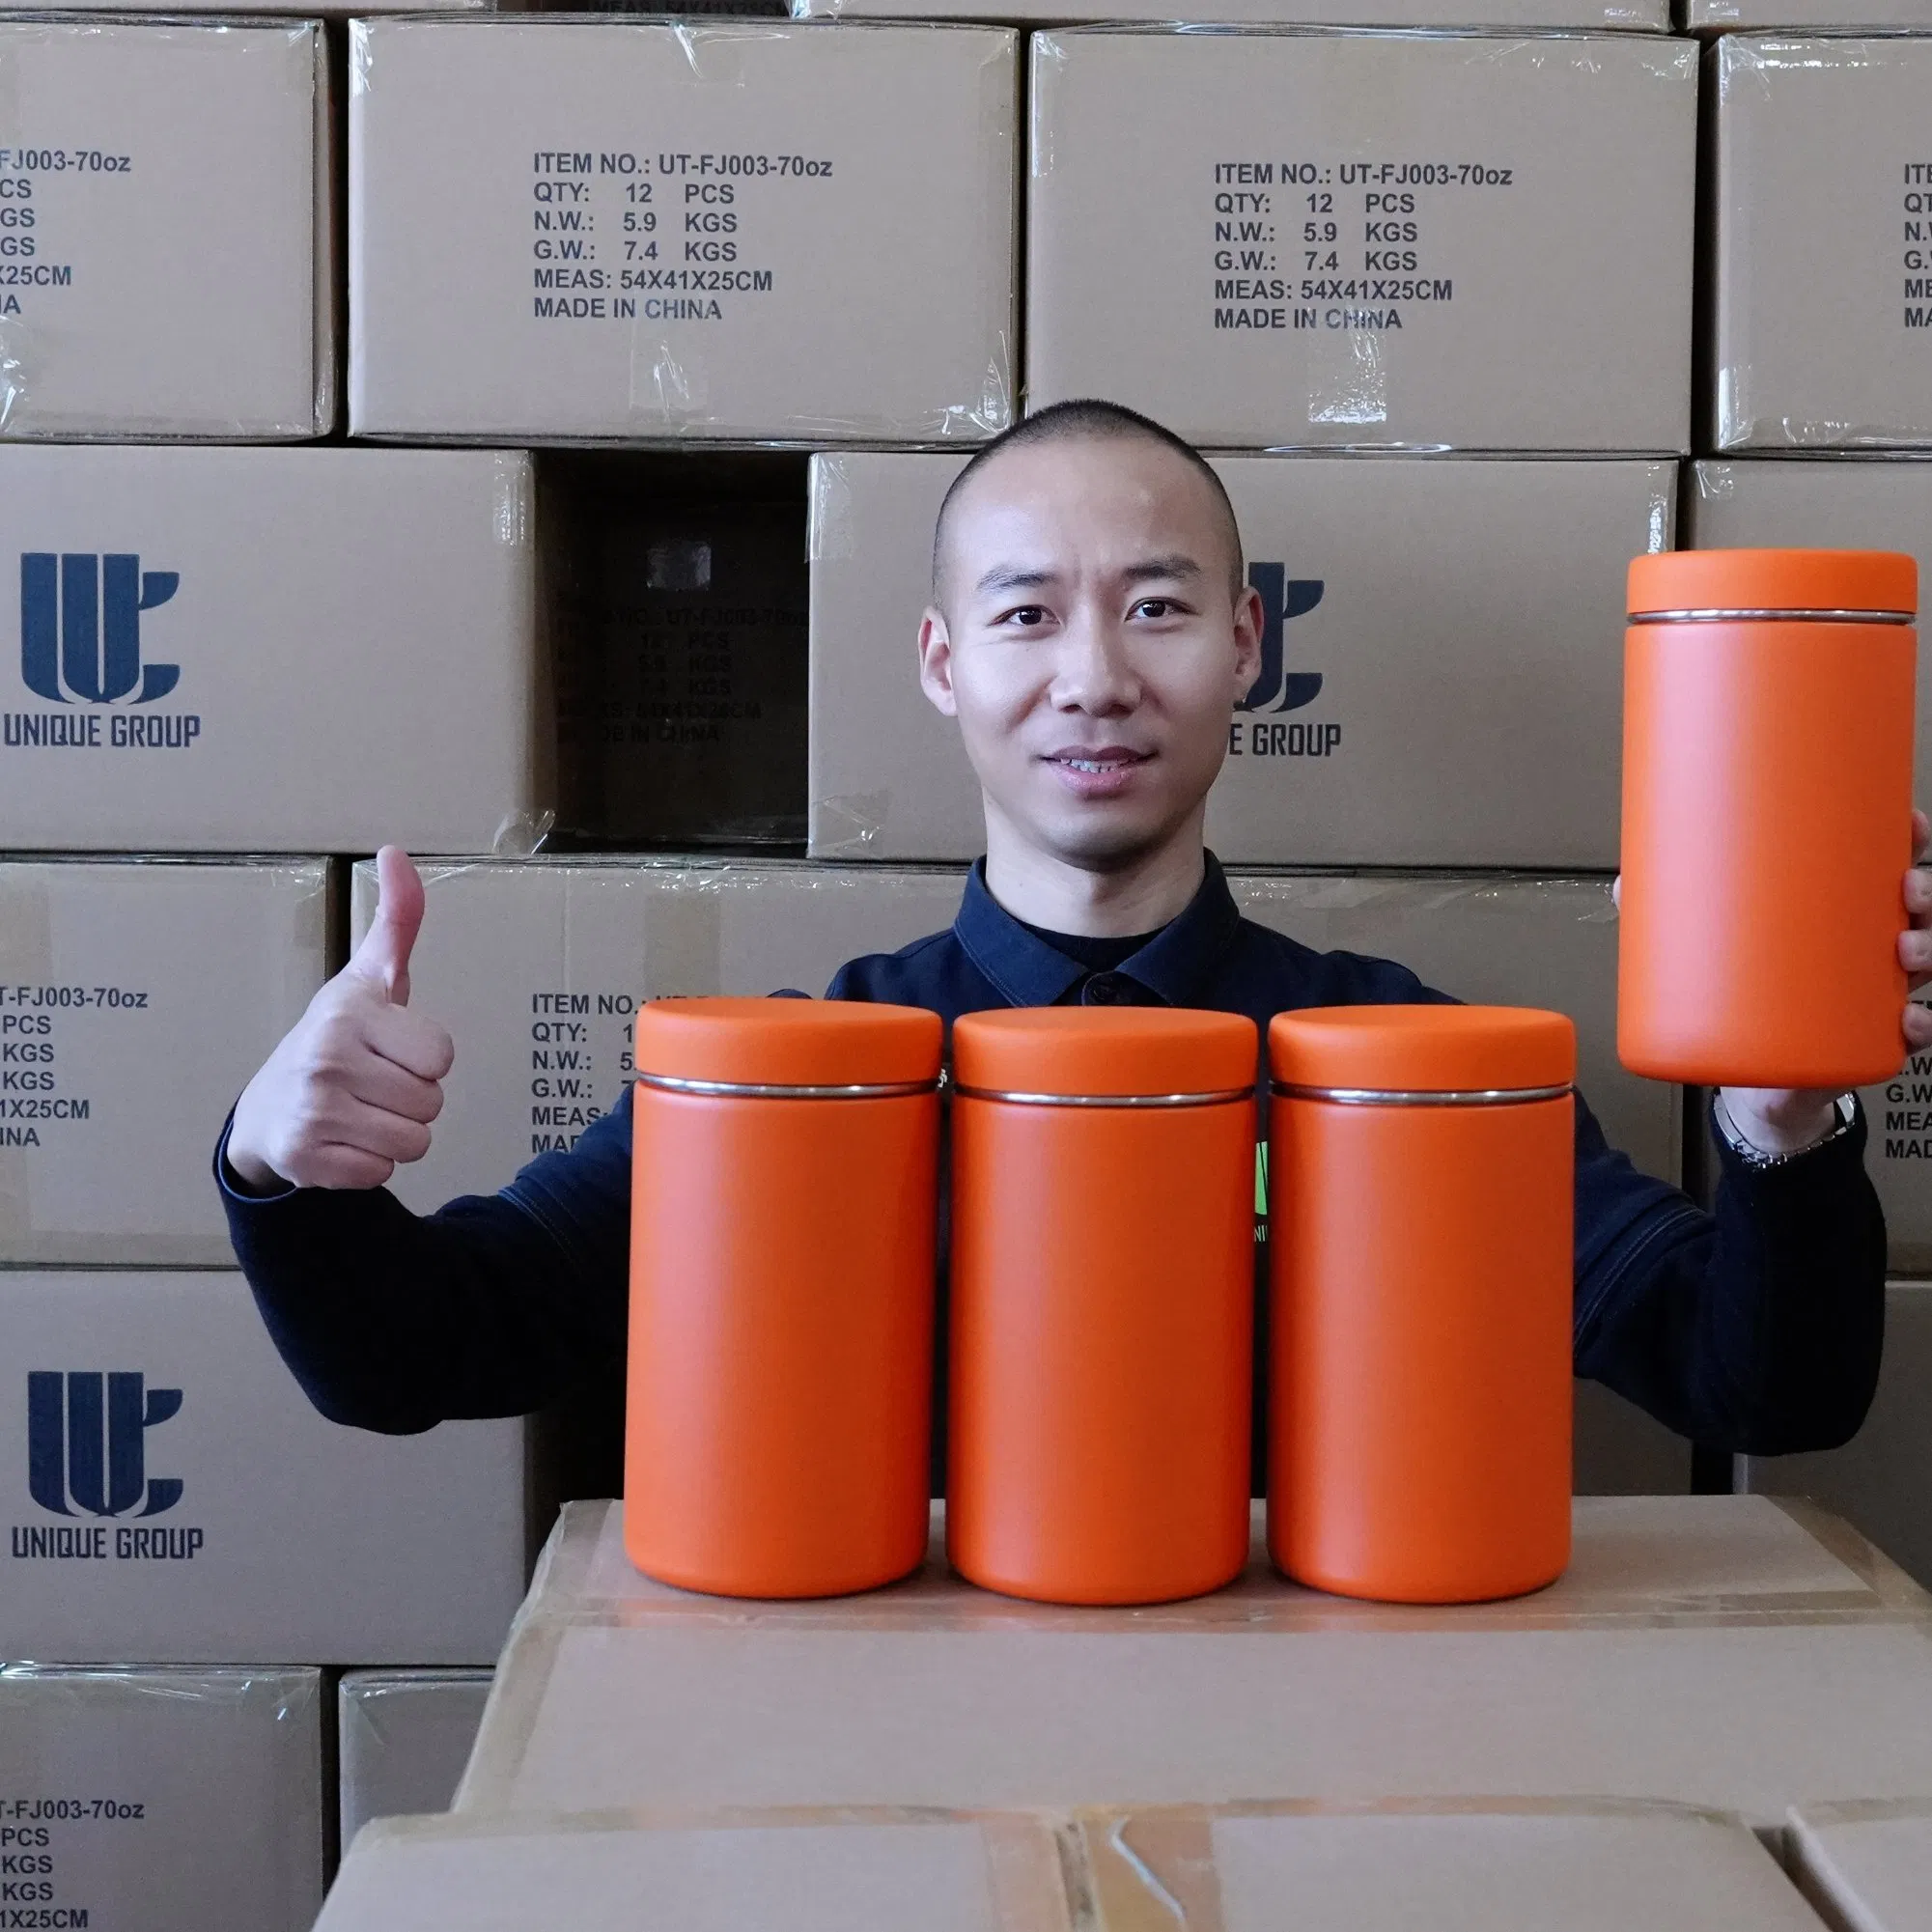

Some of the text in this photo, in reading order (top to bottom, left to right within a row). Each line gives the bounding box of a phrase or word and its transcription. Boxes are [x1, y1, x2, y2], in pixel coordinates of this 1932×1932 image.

[534, 153, 832, 177] ITEM NO.: UT-FJ003-70oz
[1216, 163, 1512, 185] ITEM NO.: UT-FJ003-70oz
[534, 182, 734, 204] QTY: 12 PCS
[1215, 193, 1414, 213] QTY: 12 PCS
[535, 210, 737, 233] N.W.: 5.9 KGS
[1905, 222, 1932, 241] N.
[1216, 222, 1417, 242] N.W.: 5.9 KGS
[534, 239, 737, 262] G.W.: 7.4 KGS
[1904, 250, 1932, 270] G.
[1215, 251, 1417, 271] G.W.: 7.4 KGS
[535, 268, 772, 291] MEAS: 54X41X25CM
[1216, 280, 1452, 300] MEAS: 54X41X25CM
[535, 297, 722, 320] MADE IN CHINA
[1215, 308, 1402, 329] MADE IN CHINA
[4, 714, 201, 747] UNIQUE GROUP
[1252, 722, 1342, 756] GROUP
[533, 994, 590, 1014] ITEM
[3, 1015, 51, 1034] PCS
[532, 1022, 587, 1043] QTY:
[3, 1043, 54, 1062] KGS
[533, 1050, 592, 1071] N.W.:
[3, 1072, 54, 1091] KGS
[531, 1078, 593, 1099] G.W.:
[532, 1134, 579, 1153] MA
[12, 1526, 204, 1559] UNIQUE GROUP
[1, 1828, 49, 1847] PCS
[2, 1855, 53, 1874] KGS
[2, 1882, 53, 1901] KGS
